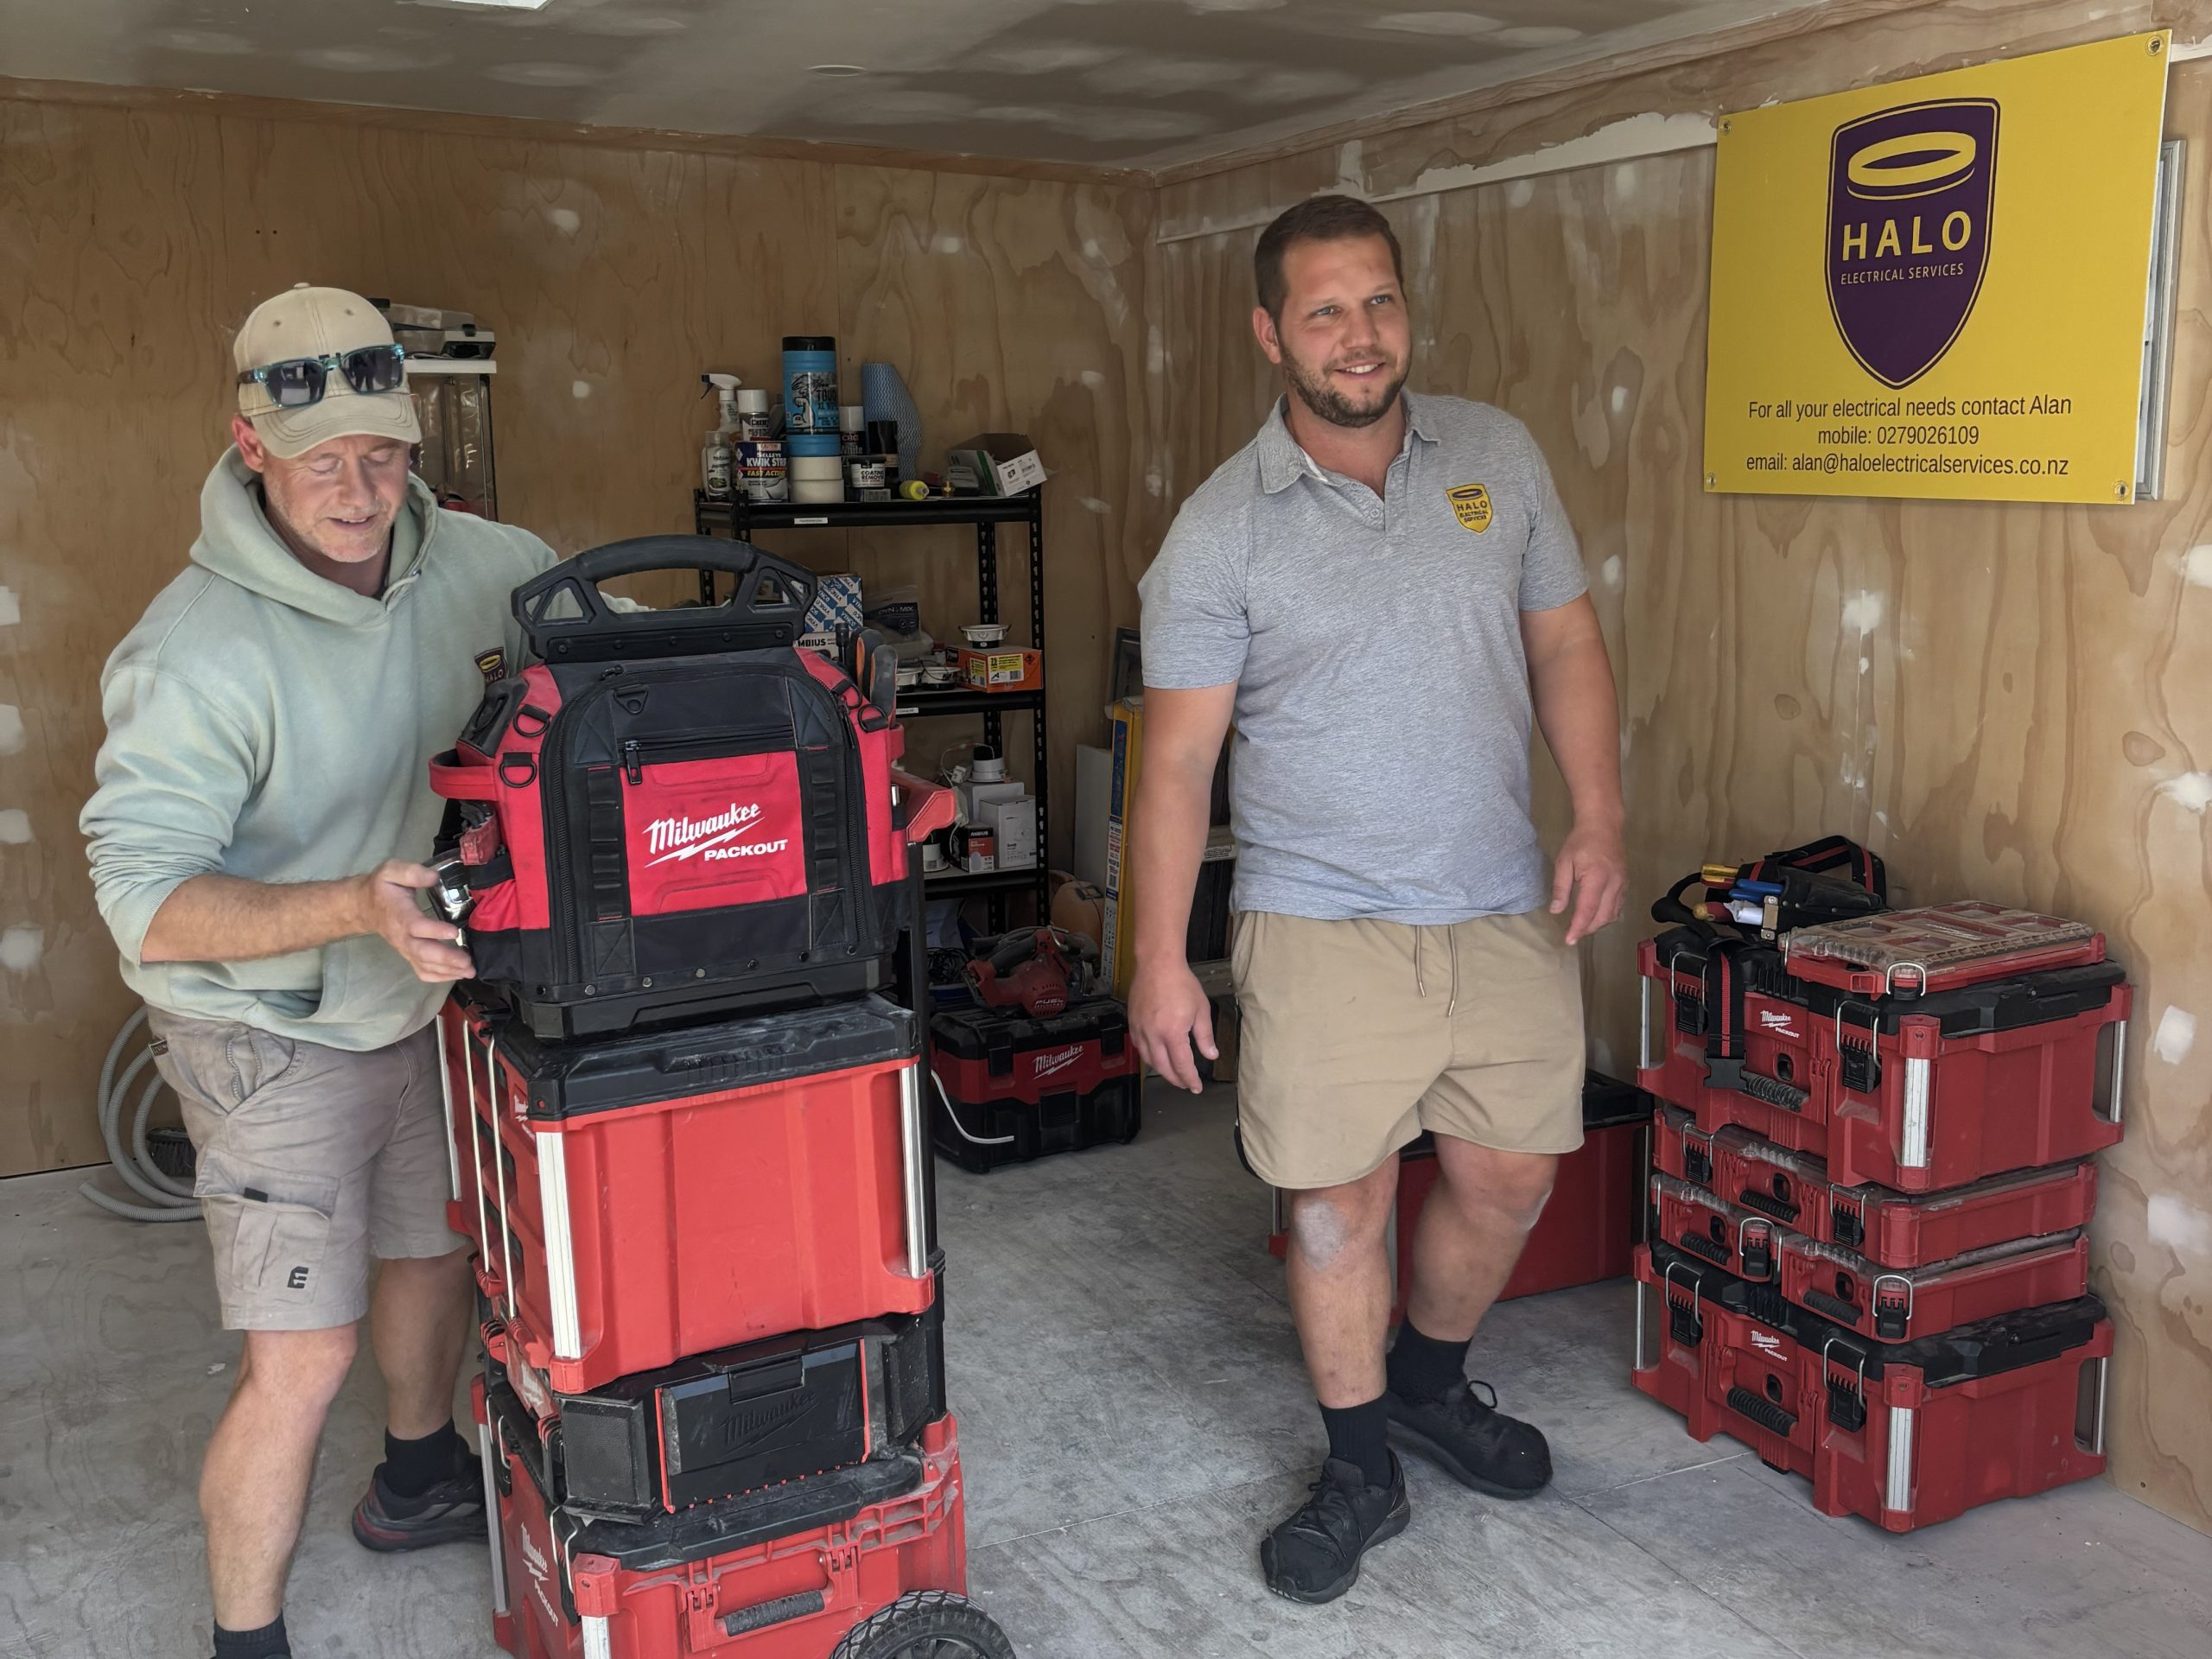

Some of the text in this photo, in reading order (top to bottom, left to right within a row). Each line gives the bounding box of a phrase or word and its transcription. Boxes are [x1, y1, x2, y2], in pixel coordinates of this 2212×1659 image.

[1842, 211, 1971, 261] HALO
[1840, 263, 1964, 285] ELECTRICAL SERVICES
[1749, 394, 2072, 423] For all your electrical needs contact Alan
[1818, 426, 1980, 445] mobile: 0279026109
[747, 458, 771, 467] KWIK
[1746, 453, 2069, 474] email: alan@haloelectricalservices.co.nz
[1456, 500, 1488, 512] HALO
[641, 803, 761, 855] Milwaukee
[704, 839, 788, 861] PACKOUT
[1032, 1046, 1084, 1073] Milwaukee
[718, 1391, 817, 1446] Milwaukee
